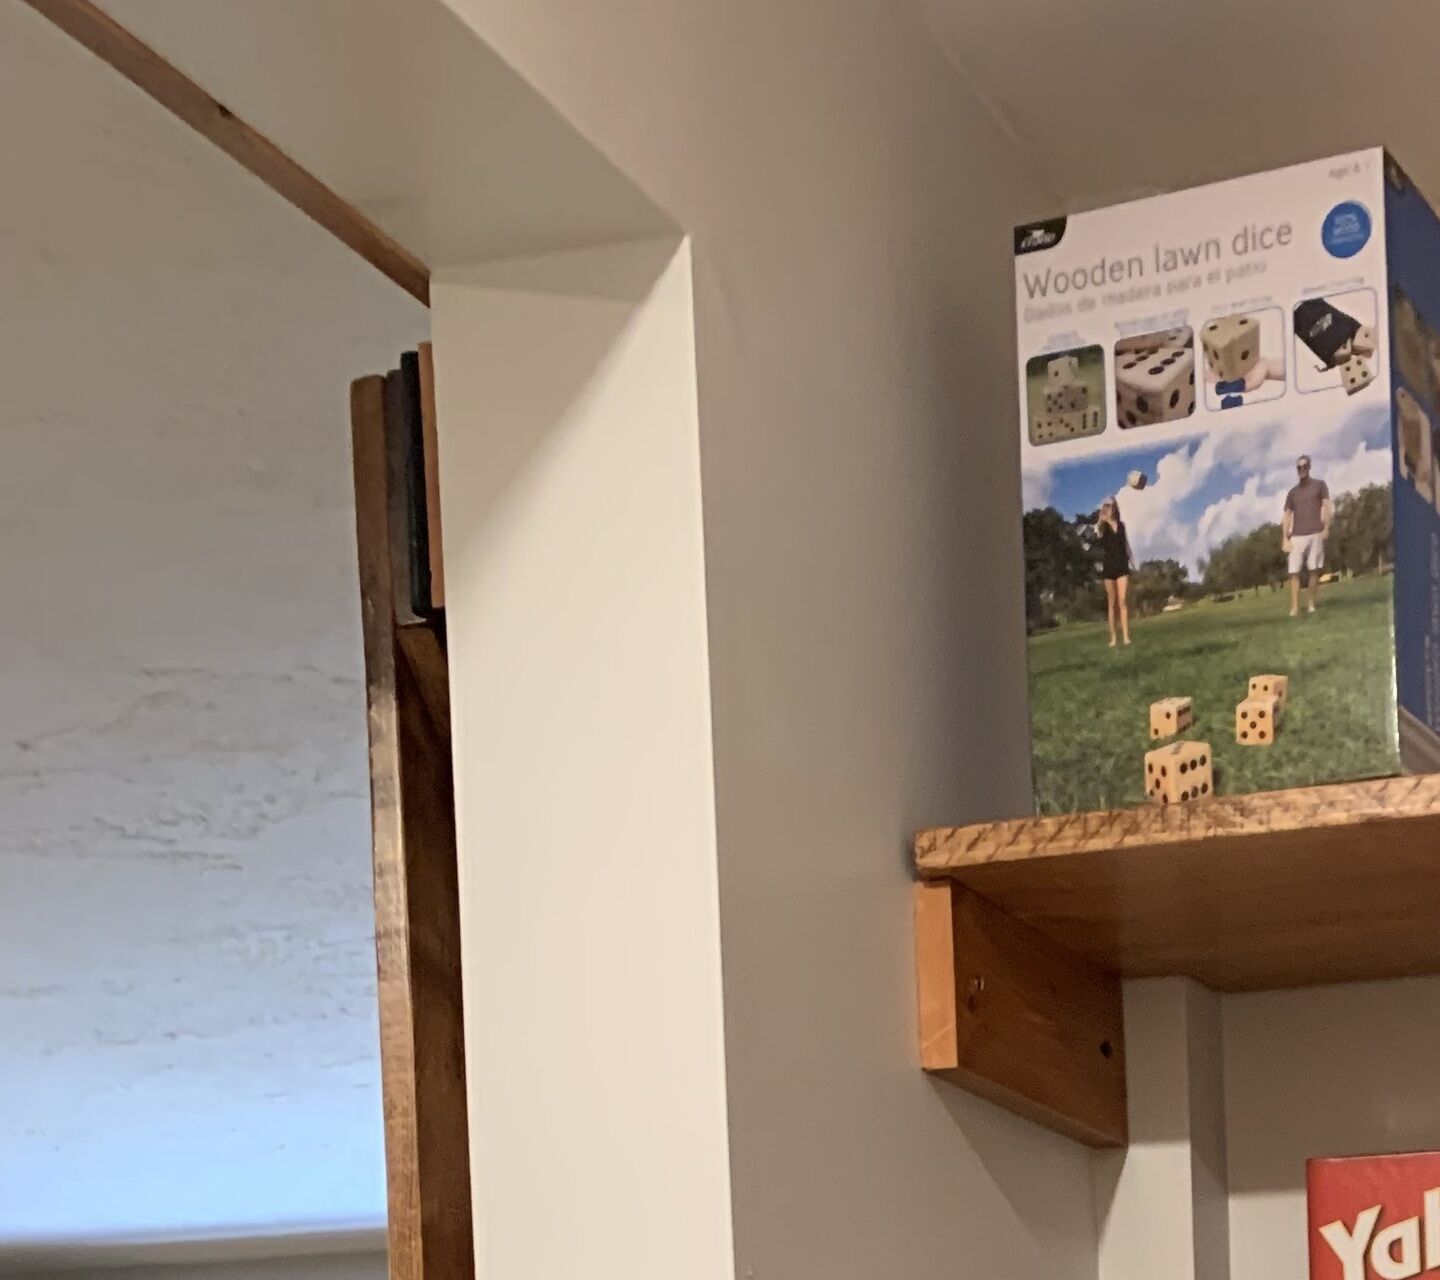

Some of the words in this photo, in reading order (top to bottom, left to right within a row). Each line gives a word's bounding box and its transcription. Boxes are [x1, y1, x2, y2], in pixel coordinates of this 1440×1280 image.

[1023, 256, 1144, 299] Wooden
[1154, 238, 1221, 273] lawn
[1232, 221, 1292, 256] dice
